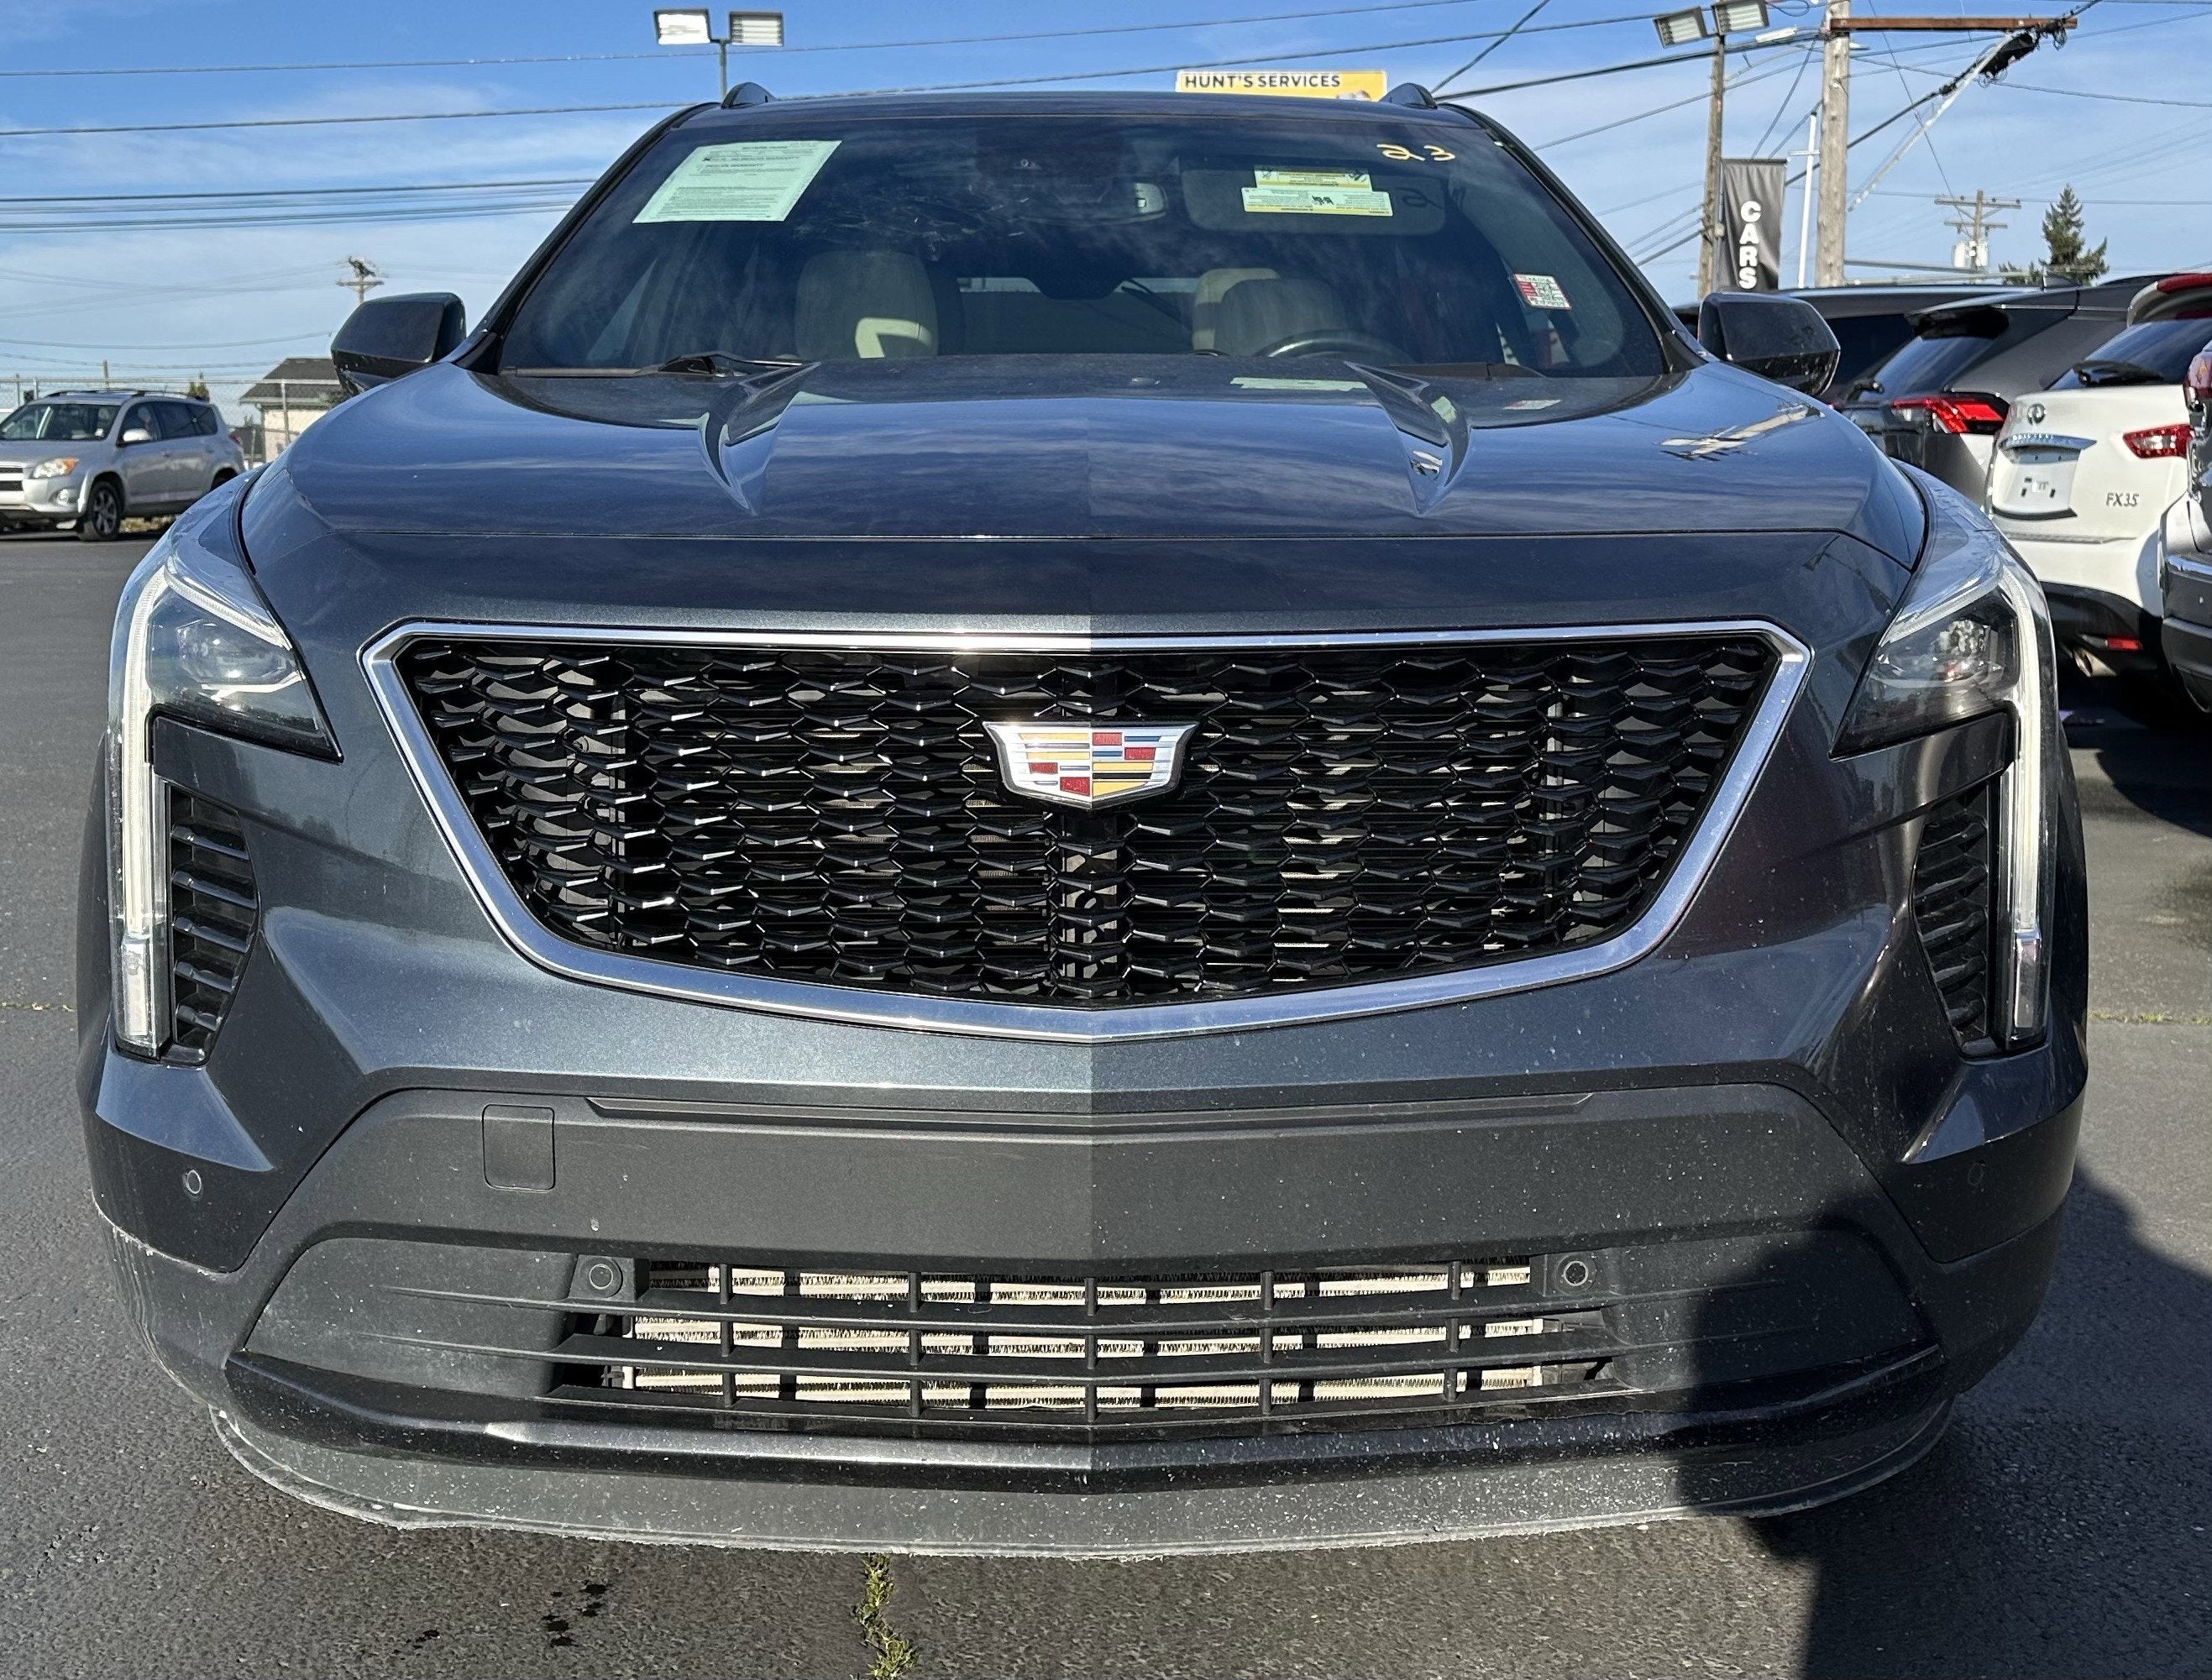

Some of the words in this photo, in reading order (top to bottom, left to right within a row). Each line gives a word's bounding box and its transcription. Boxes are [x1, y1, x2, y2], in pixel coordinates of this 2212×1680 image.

[1185, 76, 1253, 87] HUNT'S
[1258, 75, 1340, 87] SERVICES
[1738, 201, 1762, 290] CARS
